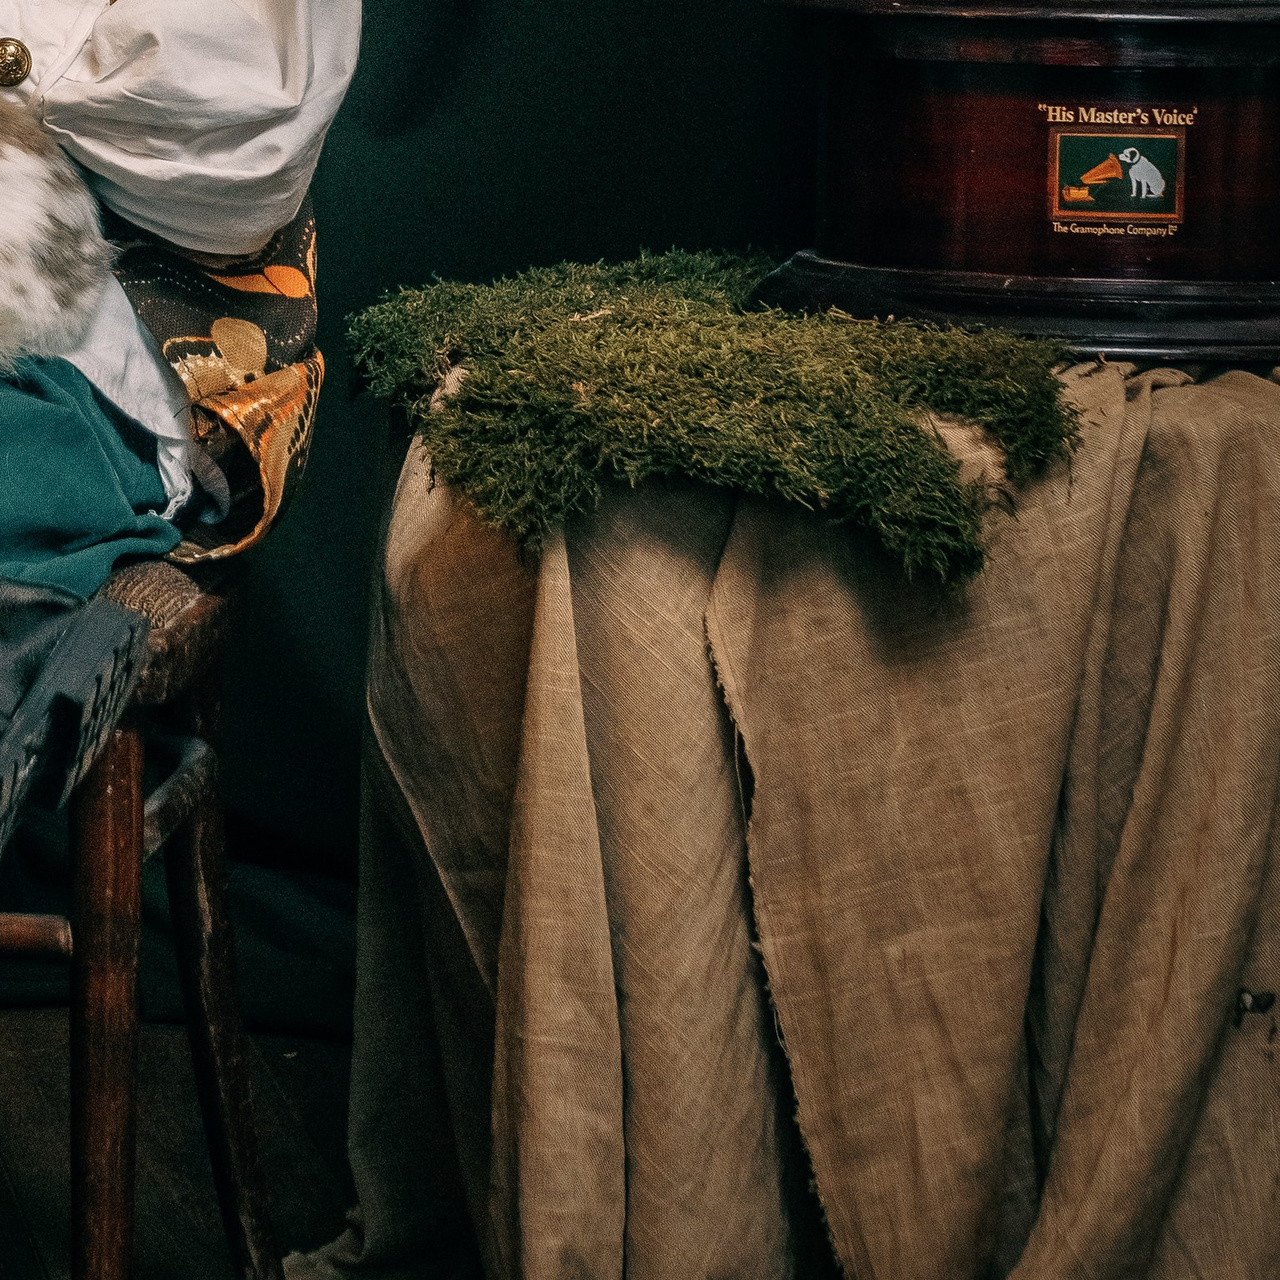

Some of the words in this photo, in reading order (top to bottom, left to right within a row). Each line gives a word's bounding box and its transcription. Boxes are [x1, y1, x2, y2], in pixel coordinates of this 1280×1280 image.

[1078, 106, 1149, 125] Master's
[1052, 221, 1068, 233] The
[1070, 223, 1126, 237] Gramophone
[1126, 224, 1168, 238] Company
